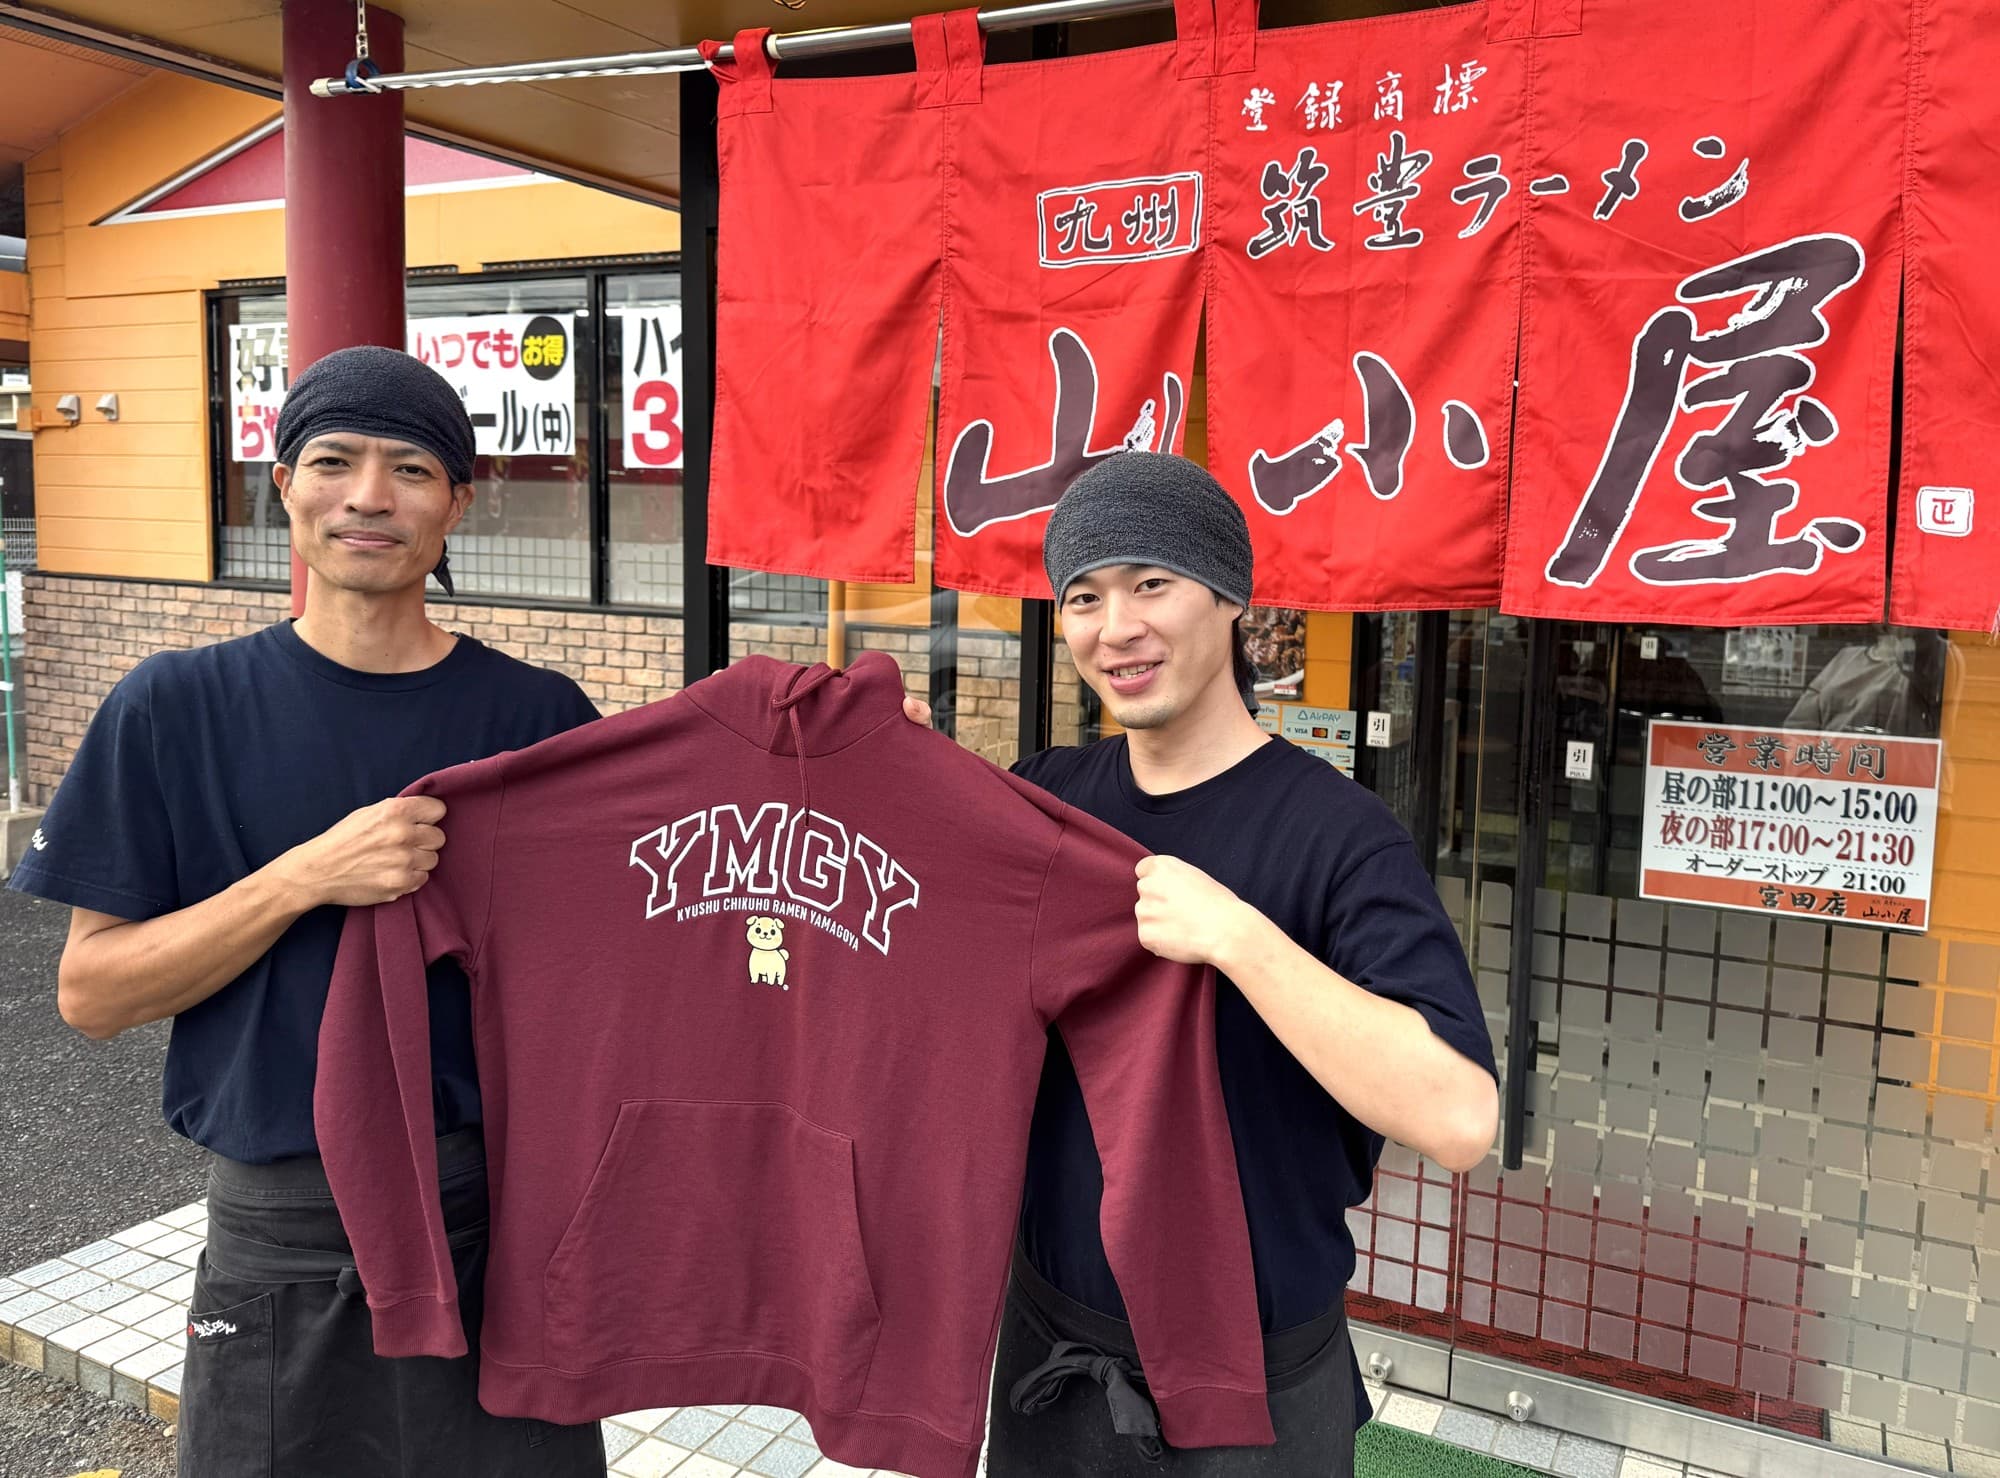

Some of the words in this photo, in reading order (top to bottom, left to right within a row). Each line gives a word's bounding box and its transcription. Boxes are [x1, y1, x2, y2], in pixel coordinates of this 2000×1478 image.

[1241, 59, 1488, 132] 登録商標
[1055, 191, 1179, 254] 九州
[1247, 132, 1749, 258] 筑豊ラーメン
[415, 328, 519, 369] いつでも
[523, 335, 567, 368] お得
[632, 380, 683, 465] 3
[943, 233, 1867, 588] 山小屋
[1697, 732, 1887, 781] 営業時間
[629, 802, 920, 956] YMGY
[1686, 854, 1829, 886] オーダーストップ
[1842, 871, 1906, 895] 21:00
[1758, 885, 1849, 917] 宮田店
[677, 899, 720, 922] KYUSHU
[723, 897, 769, 911] CHIKUHO
[772, 899, 807, 921] RAMEN
[810, 911, 859, 952] YAMAGOYA
[1862, 906, 1912, 924] 山小屋
